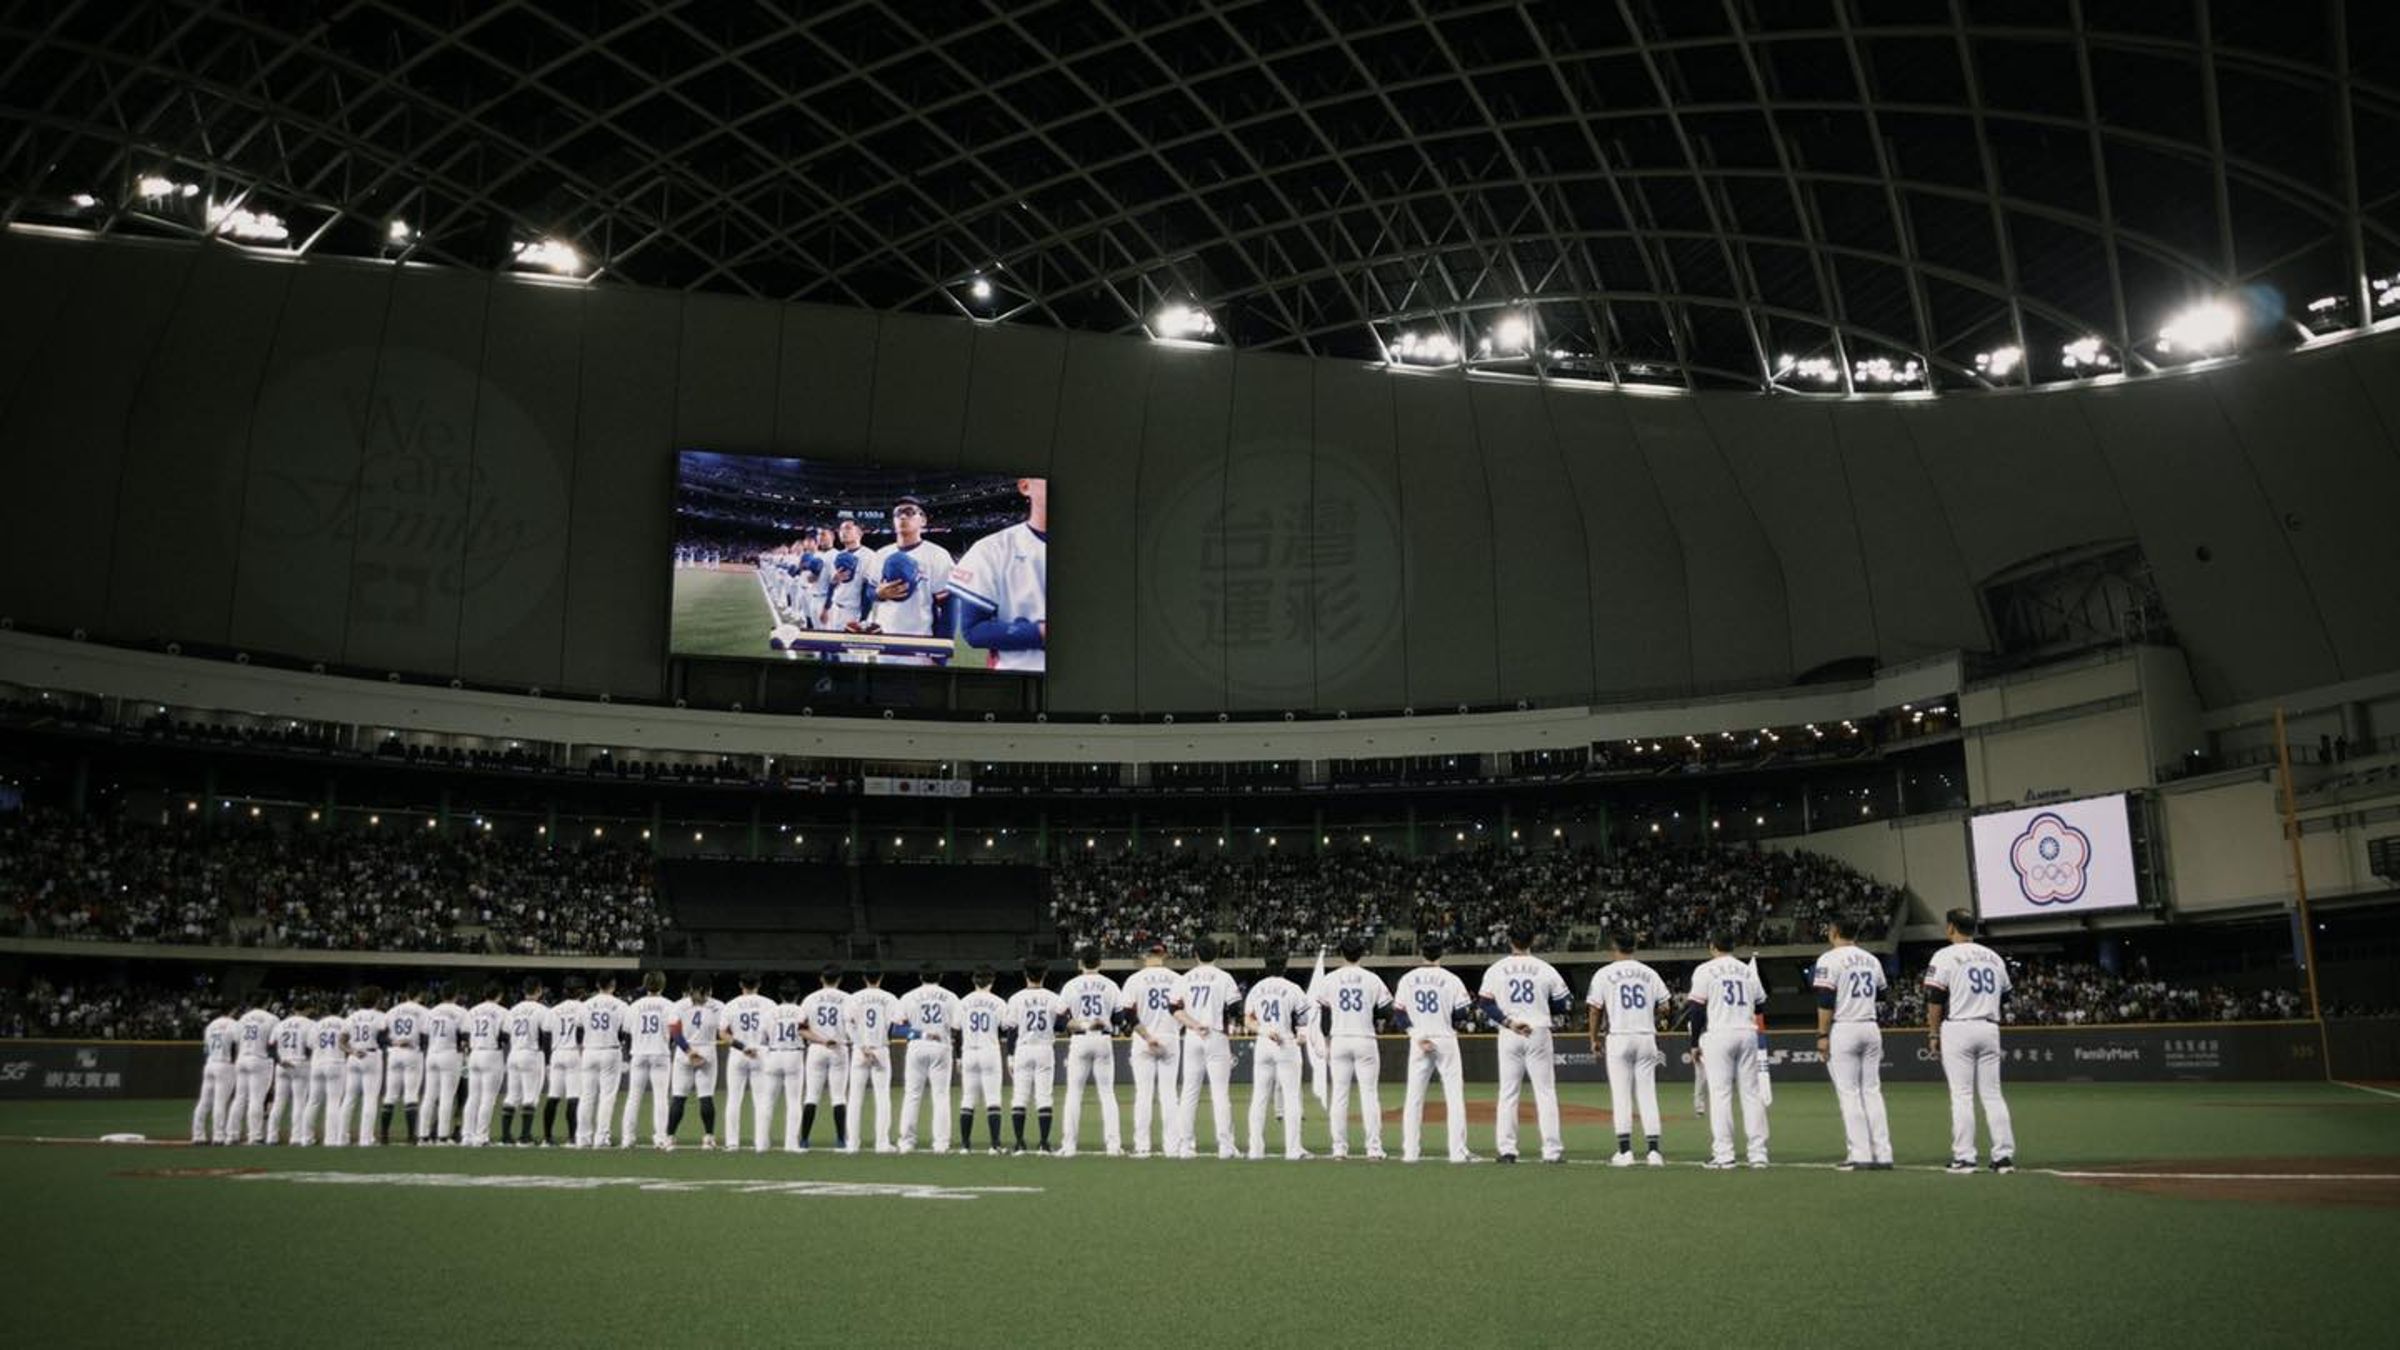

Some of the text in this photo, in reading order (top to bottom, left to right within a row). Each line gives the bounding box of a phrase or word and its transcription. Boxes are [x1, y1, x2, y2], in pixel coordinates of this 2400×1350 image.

[1200, 496, 1360, 571] 台灣
[1197, 571, 1364, 650] 運彩
[1510, 979, 1534, 1004] 28
[1850, 971, 1873, 998] 23
[1968, 968, 1996, 994] 99
[1149, 988, 1171, 1010] 85
[1190, 986, 1211, 1008] 77
[1339, 988, 1363, 1012] 83
[1415, 990, 1439, 1013] 98
[1620, 984, 1646, 1009] 66
[1722, 980, 1747, 1006] 31
[817, 1006, 838, 1026] 58
[921, 1003, 942, 1024] 32
[1081, 995, 1102, 1017] 35
[1262, 999, 1280, 1022] 24
[474, 1019, 489, 1037] 12
[591, 1012, 609, 1031] 59
[641, 1014, 659, 1034] 19
[692, 1011, 702, 1028] 4
[740, 1012, 760, 1031] 95
[866, 1008, 876, 1028] 9
[970, 1012, 989, 1032] 90
[1027, 1010, 1047, 1031] 25
[778, 1022, 796, 1042] 14
[2074, 1046, 2140, 1062] FamilyMart
